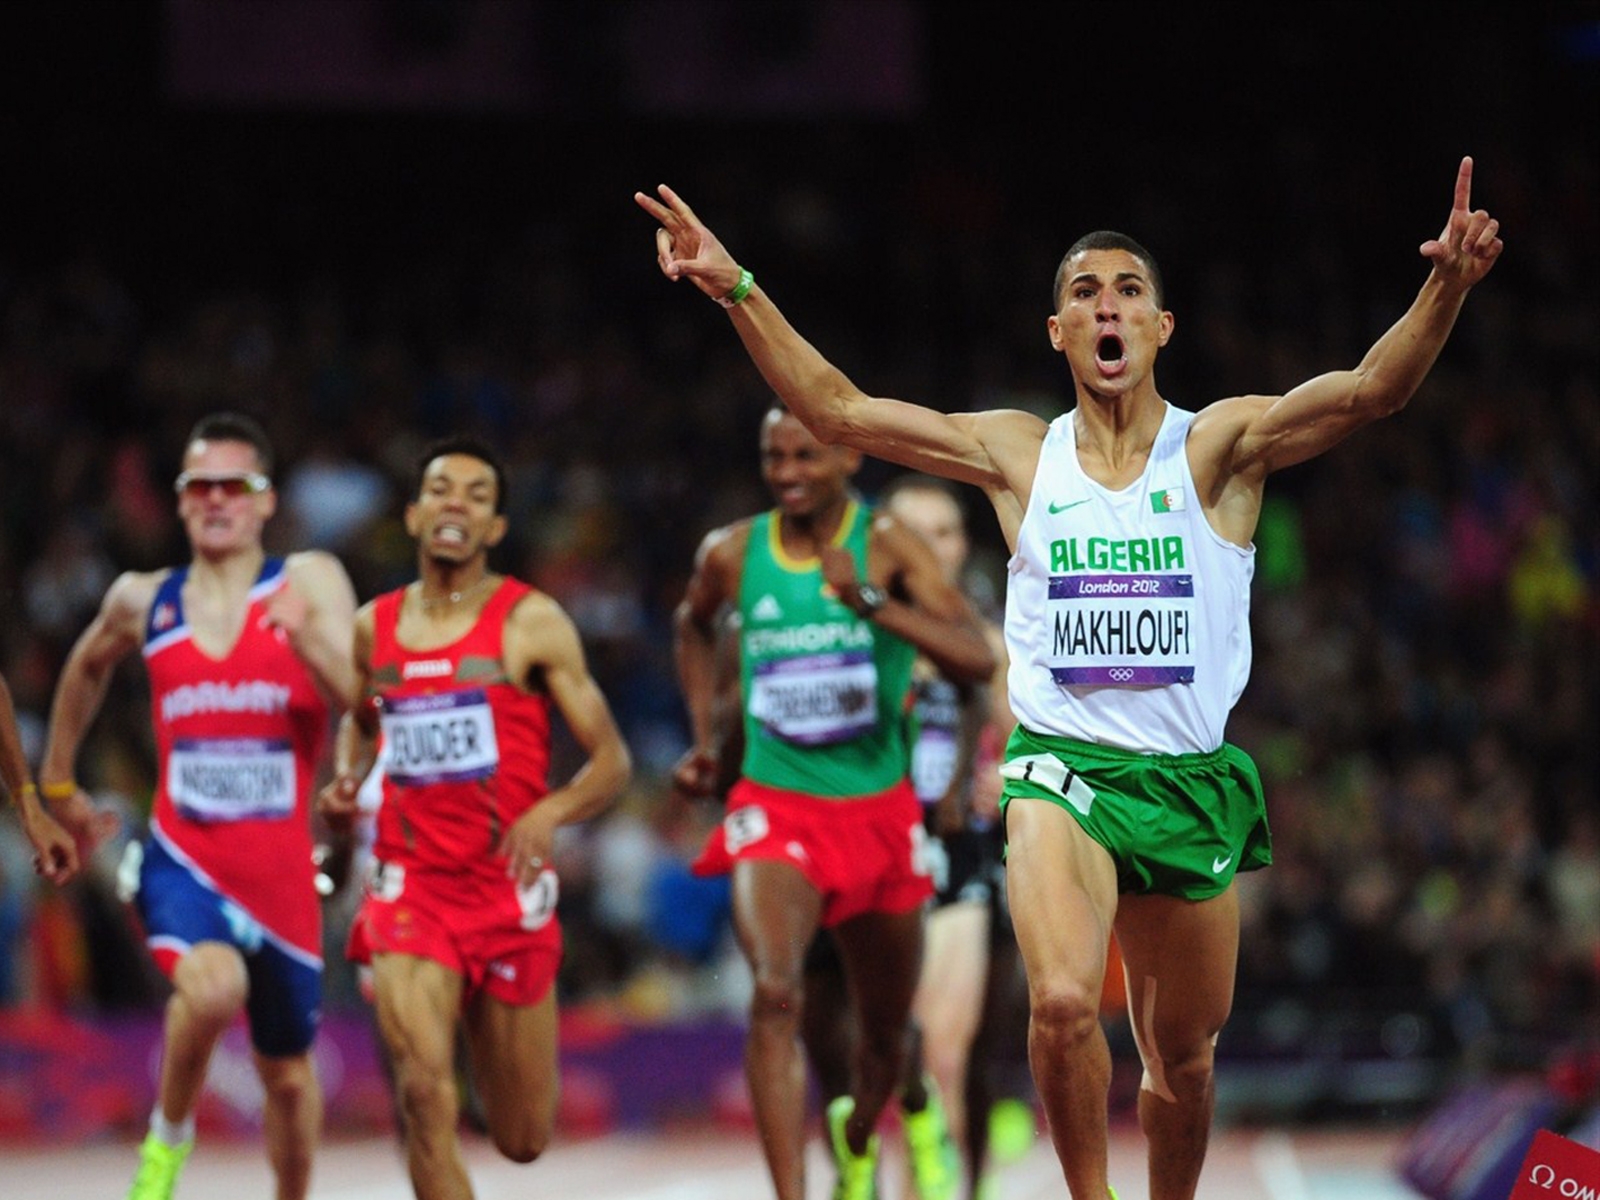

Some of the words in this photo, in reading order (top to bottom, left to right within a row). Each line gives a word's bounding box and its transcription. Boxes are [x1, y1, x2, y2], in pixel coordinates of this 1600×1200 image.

[1050, 536, 1185, 572] ALGERIA
[1079, 579, 1128, 594] London
[1131, 579, 1160, 593] 2012
[1053, 609, 1190, 656] MAKHLOUFI
